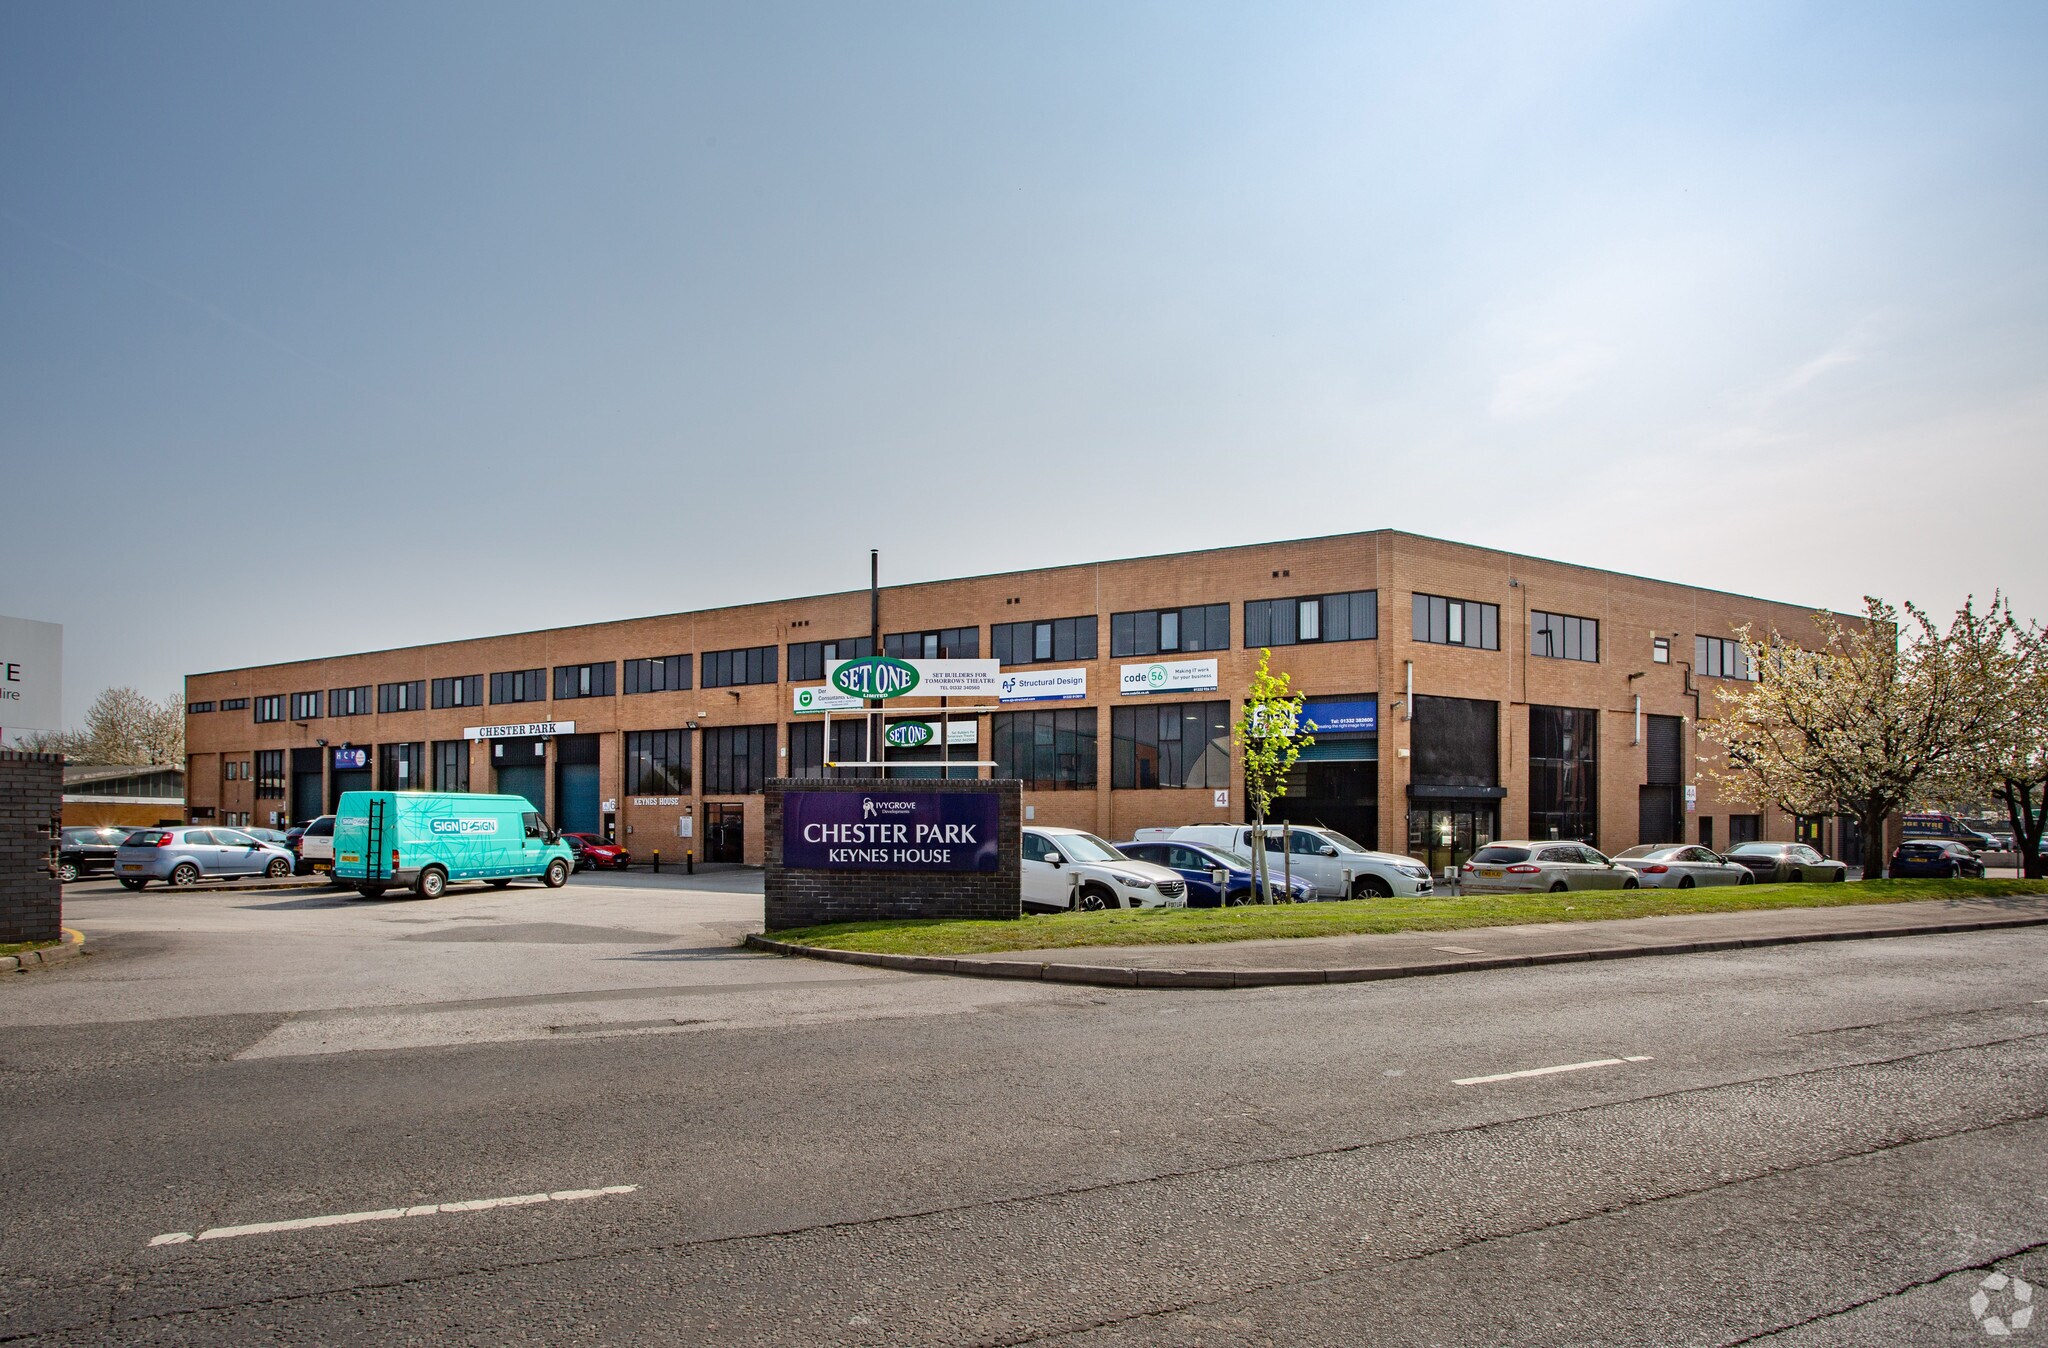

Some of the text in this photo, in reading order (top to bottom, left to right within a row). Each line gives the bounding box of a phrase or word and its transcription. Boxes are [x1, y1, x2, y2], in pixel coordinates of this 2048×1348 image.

[839, 663, 911, 694] SET ONE
[1019, 677, 1083, 687] Structural Design
[1124, 671, 1163, 682] code 56
[480, 723, 557, 737] CHESTER PARK
[889, 725, 927, 744] SET ONE
[633, 797, 679, 806] KEYNES HOUSE
[1216, 792, 1227, 805] 4
[610, 800, 616, 810] 6
[875, 801, 916, 810] IVYGROVE
[433, 821, 459, 832] SIGN
[803, 823, 977, 843] CHESTER PARK
[829, 848, 951, 863] KEYNES HOUSE
